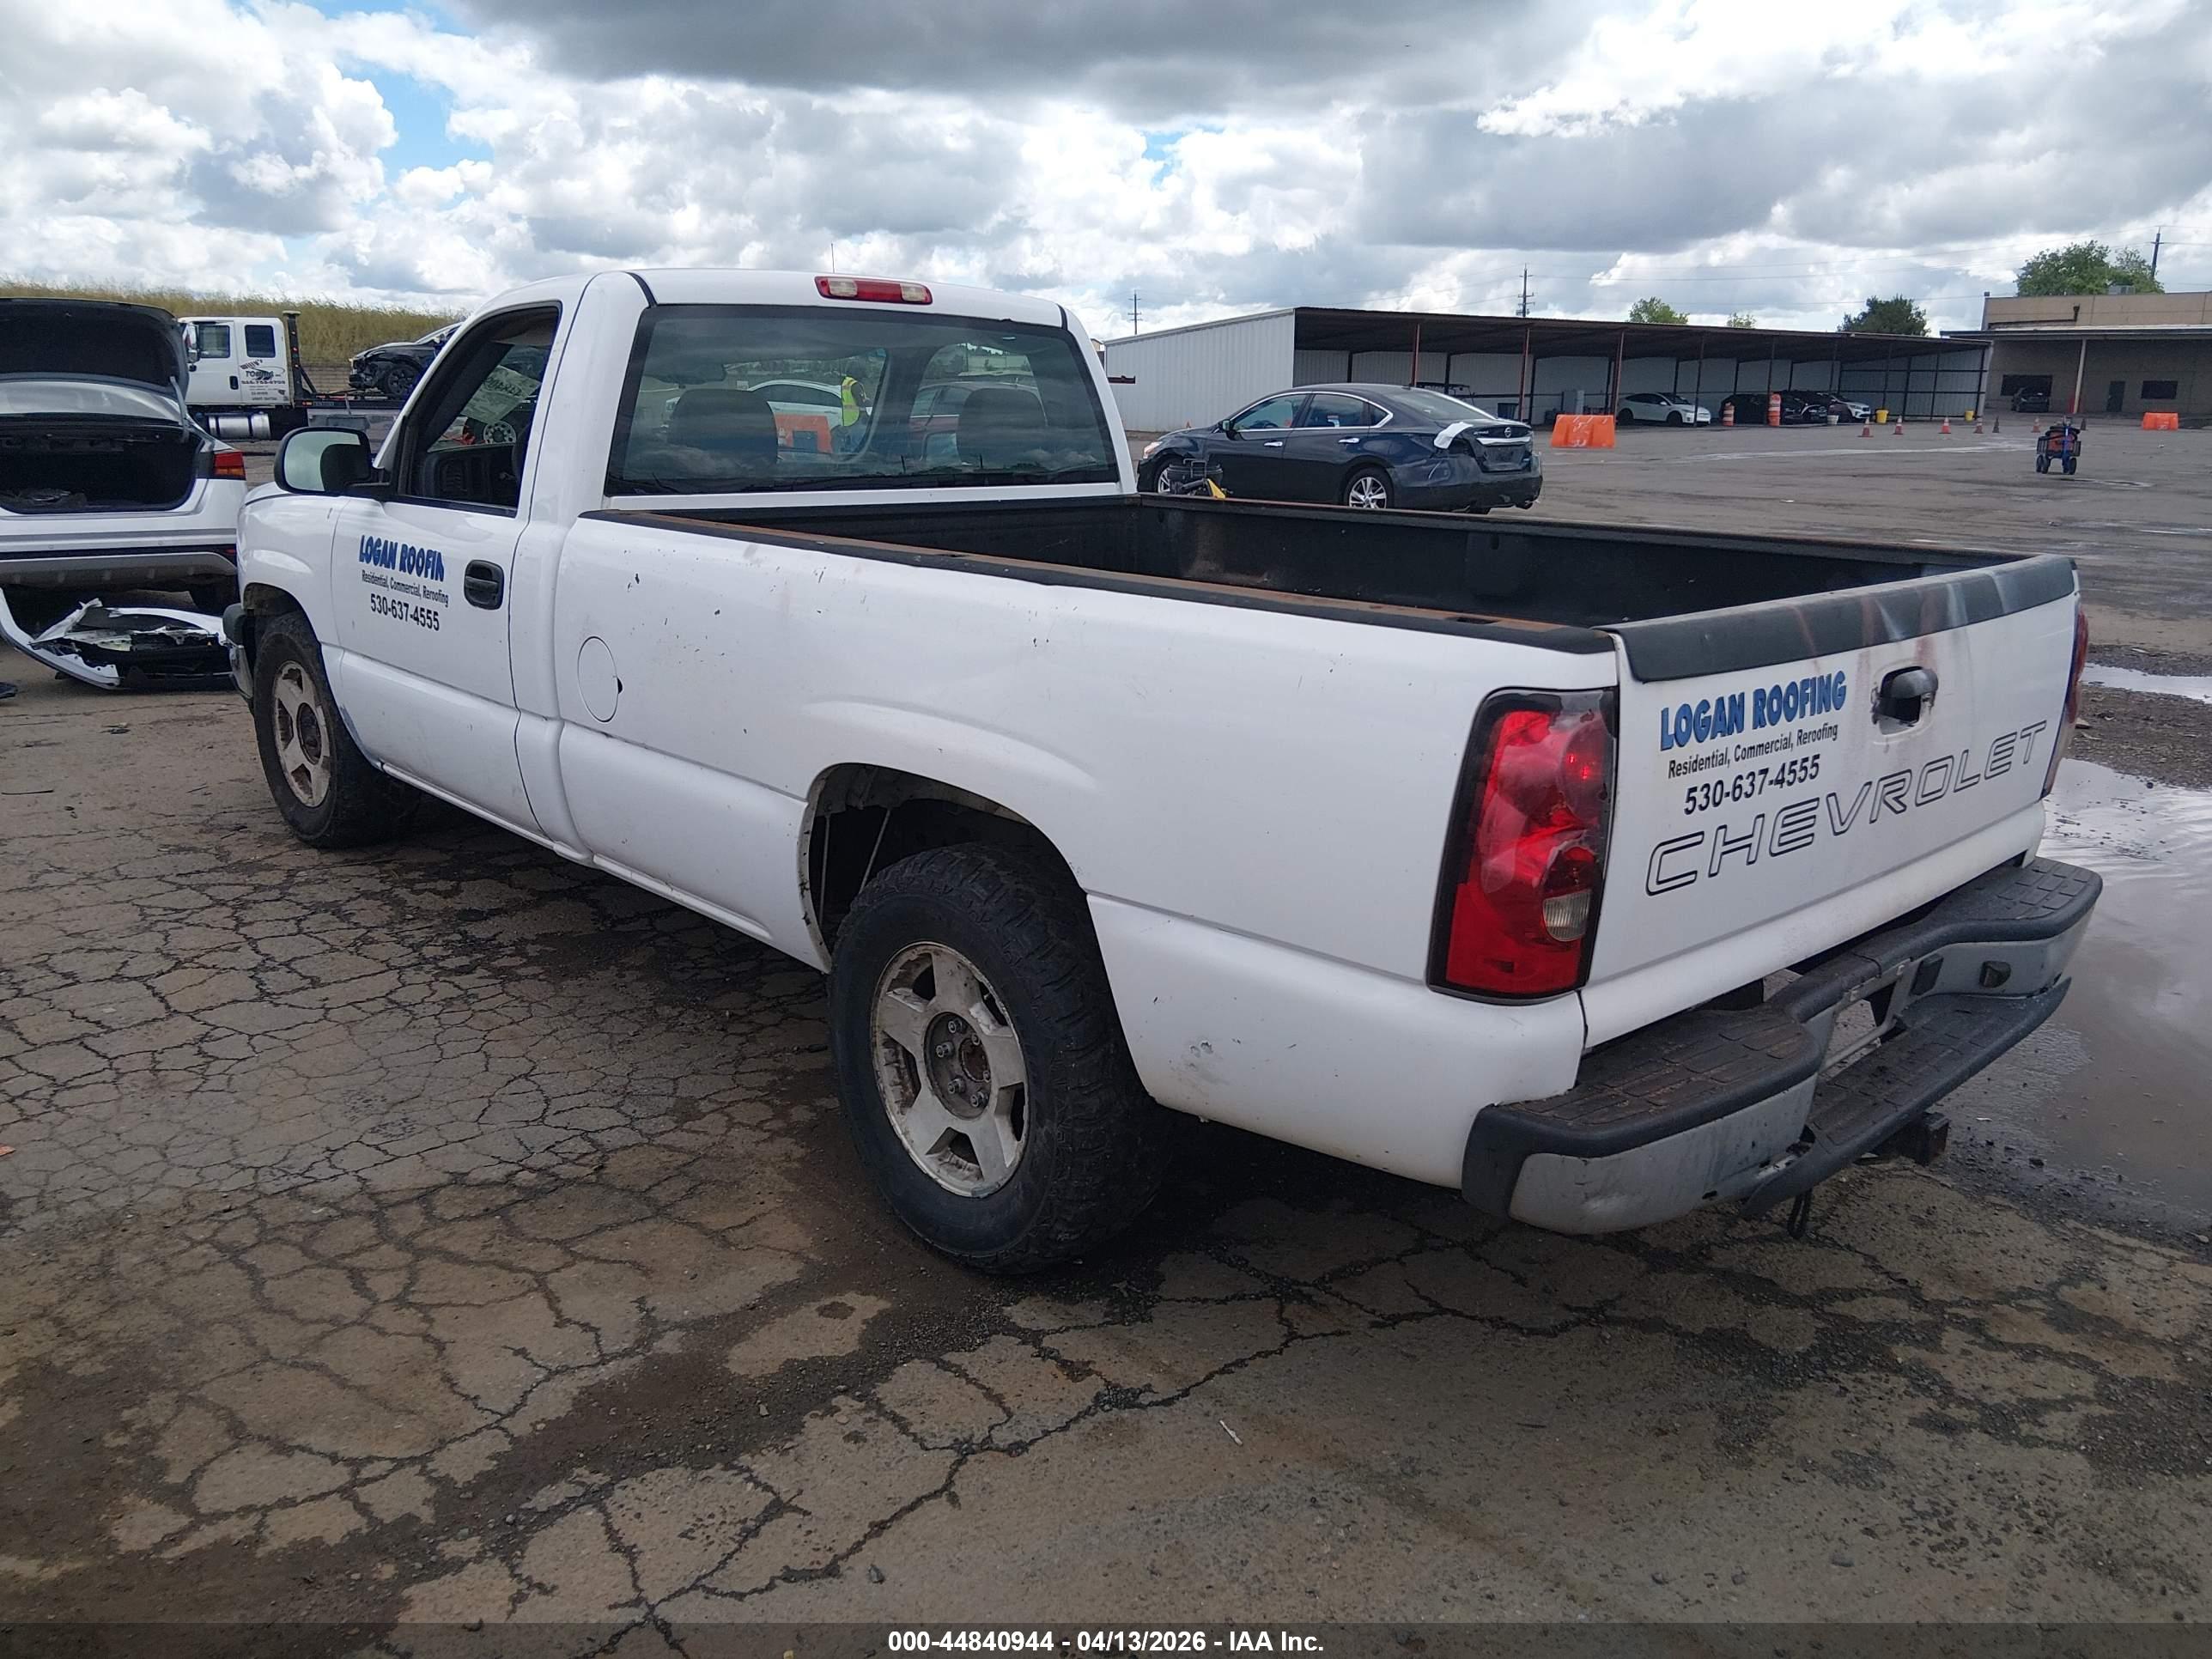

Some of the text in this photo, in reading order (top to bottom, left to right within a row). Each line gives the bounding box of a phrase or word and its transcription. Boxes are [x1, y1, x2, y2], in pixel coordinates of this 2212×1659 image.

[359, 534, 398, 570] LOGAN
[362, 569, 449, 608] Residential, Commercial, Reroofing
[370, 592, 440, 632] 530-637-4555
[1659, 670, 1847, 752] LOGAN ROOFING
[1668, 721, 1839, 779] Residential, Commercial, Reroofing
[1645, 720, 2048, 896] CHEVROLET
[1683, 753, 1821, 815] 530-637-4555
